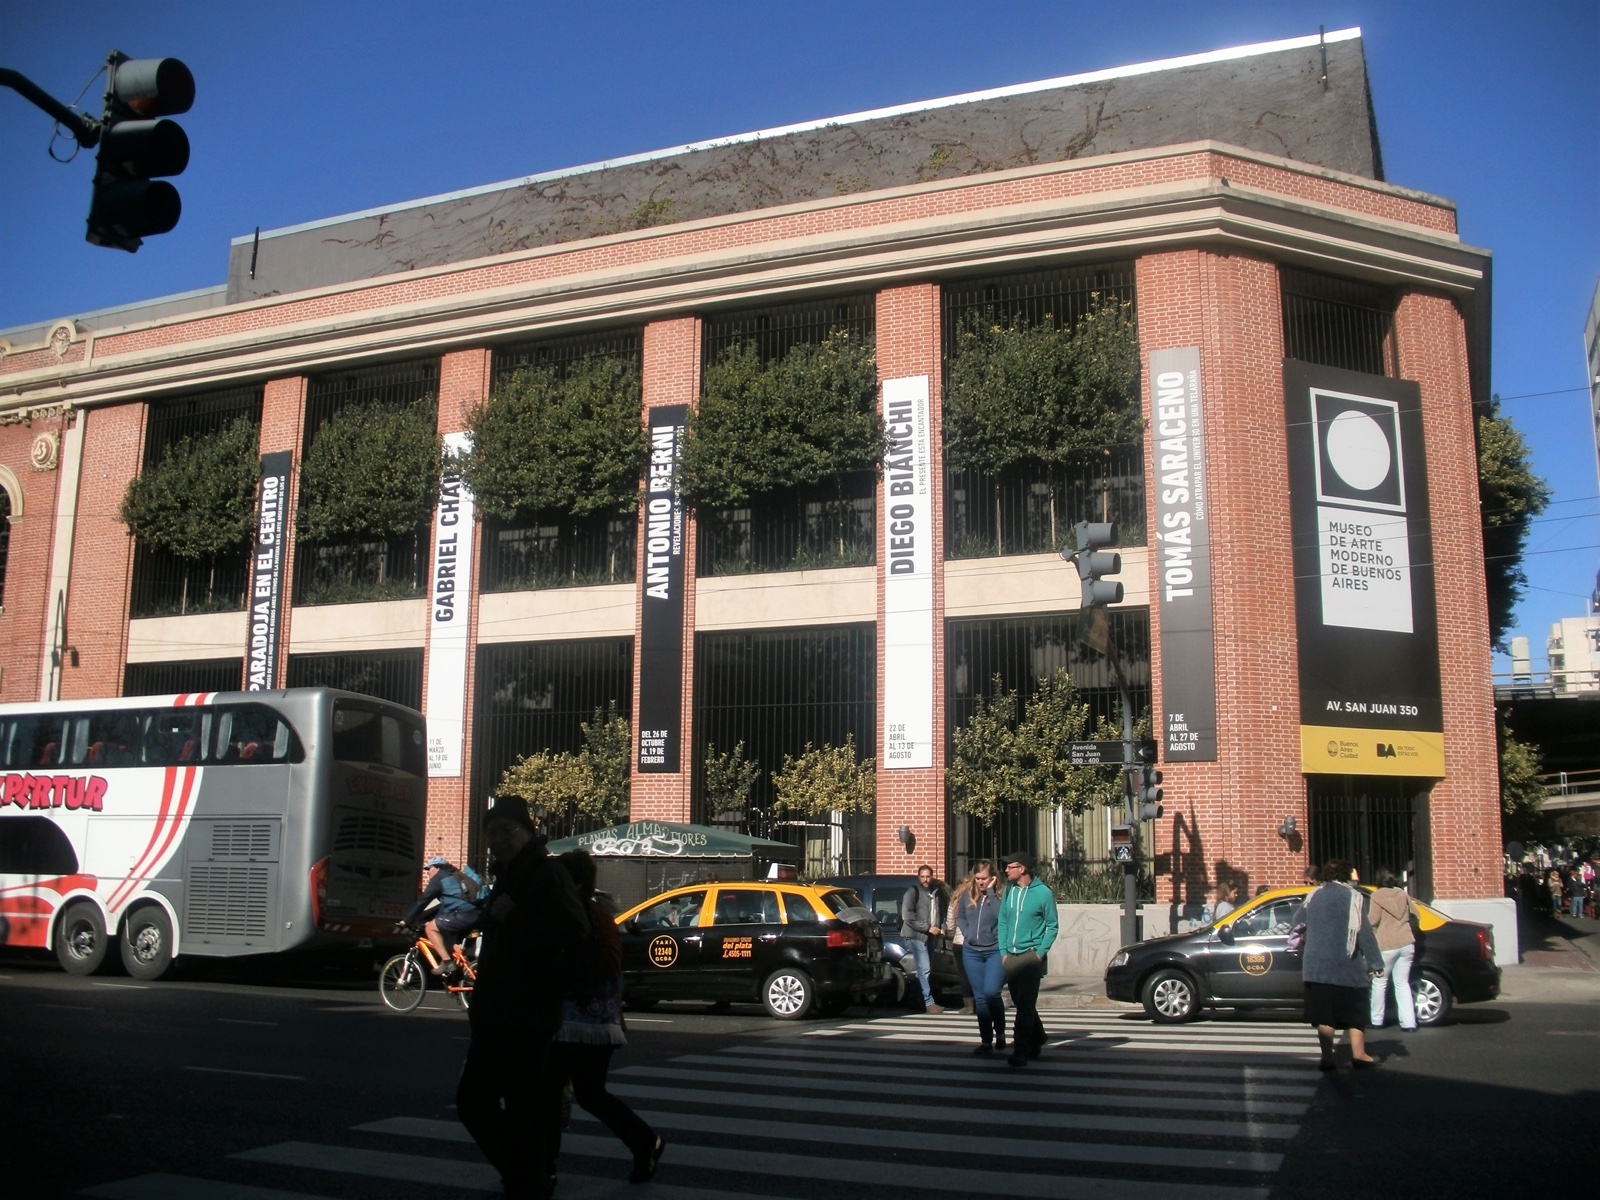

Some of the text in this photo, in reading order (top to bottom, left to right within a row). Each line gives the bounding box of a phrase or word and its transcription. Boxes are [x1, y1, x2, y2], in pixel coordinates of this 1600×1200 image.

[917, 399, 925, 437] ENCANTADOR
[1187, 370, 1204, 520] CÓMO ATRAPAR EL UNIVERSO EN UNA TELARAÑA
[918, 455, 926, 486] PRESENTE
[888, 400, 914, 575] DIEGO BIANCHI
[918, 487, 927, 495] EL
[1156, 371, 1193, 602] TOMÁS SARACENO
[259, 476, 279, 545] CENTRO
[646, 425, 674, 600] ANTONIO BERNI
[1329, 521, 1372, 537] MUSEO
[435, 475, 461, 622] GABRIEL CHAI
[1330, 535, 1382, 551] DE ARTE
[257, 548, 274, 570] EL
[1330, 549, 1393, 566] MODERNO
[1331, 563, 1402, 581] DE BUENOS
[255, 574, 272, 597] EN
[1332, 577, 1369, 591] AIRES
[1326, 700, 1418, 716] AV. SAN JUAN 350
[1169, 713, 1184, 722] 7 DE
[641, 730, 668, 738] DEL 26 DE
[1169, 723, 1189, 731] ABRIL
[641, 739, 665, 747] OCTUBRE
[1169, 732, 1199, 741] AL 27 DE
[641, 747, 665, 755] AL 19 DE
[889, 742, 896, 750] AL
[1170, 743, 1196, 751] AGOSTO
[1376, 743, 1397, 759] BA
[641, 756, 665, 764] FEBRERO
[889, 751, 912, 759] AGOSTO
[579, 829, 617, 846] PLANTAS
[655, 948, 672, 956] 12340
[735, 942, 752, 950] plata
